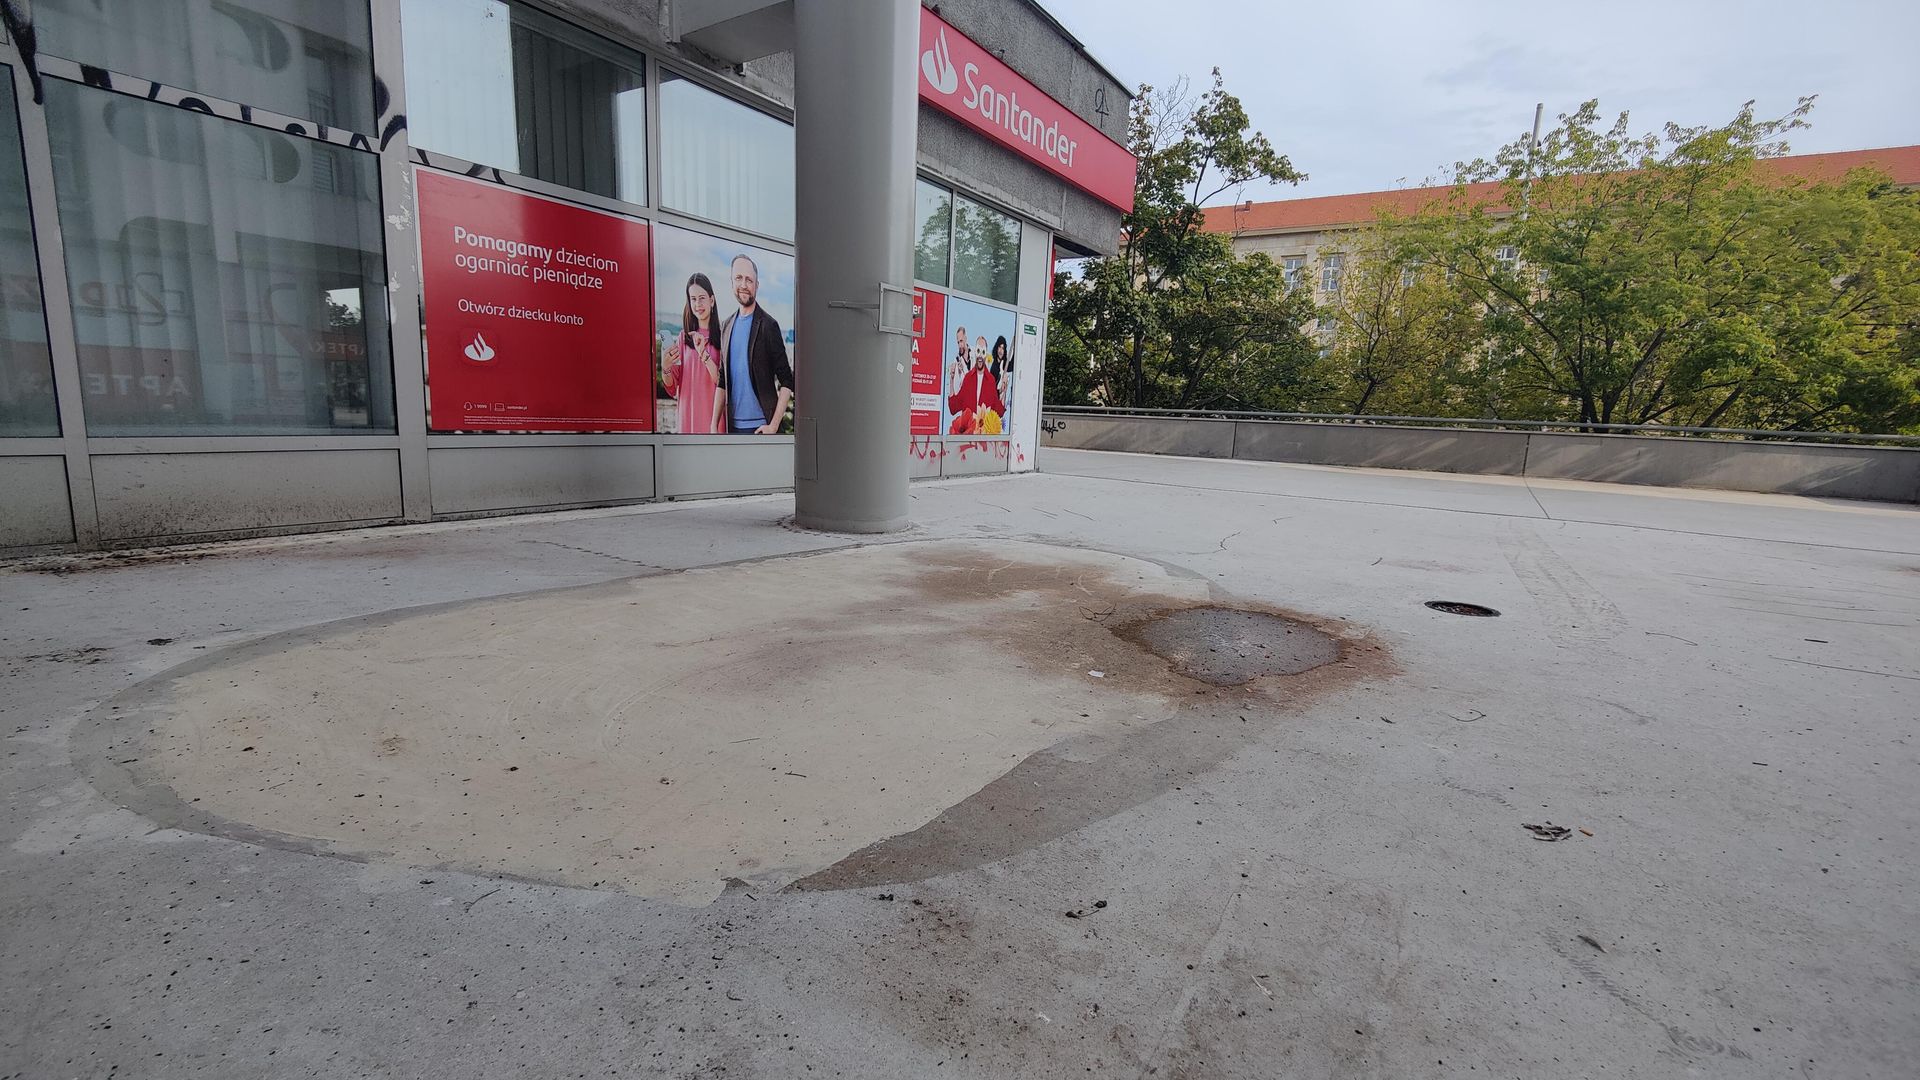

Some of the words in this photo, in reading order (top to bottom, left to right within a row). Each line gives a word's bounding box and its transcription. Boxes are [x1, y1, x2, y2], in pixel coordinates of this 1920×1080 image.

[963, 62, 1077, 168] Santander
[454, 225, 552, 263] Pomagamy
[556, 247, 619, 273] dzieciom
[455, 254, 529, 278] ogarniać
[533, 266, 603, 290] pieniądze
[458, 299, 505, 317] Otwórz
[508, 305, 551, 322] dziecku
[554, 311, 584, 326] konto
